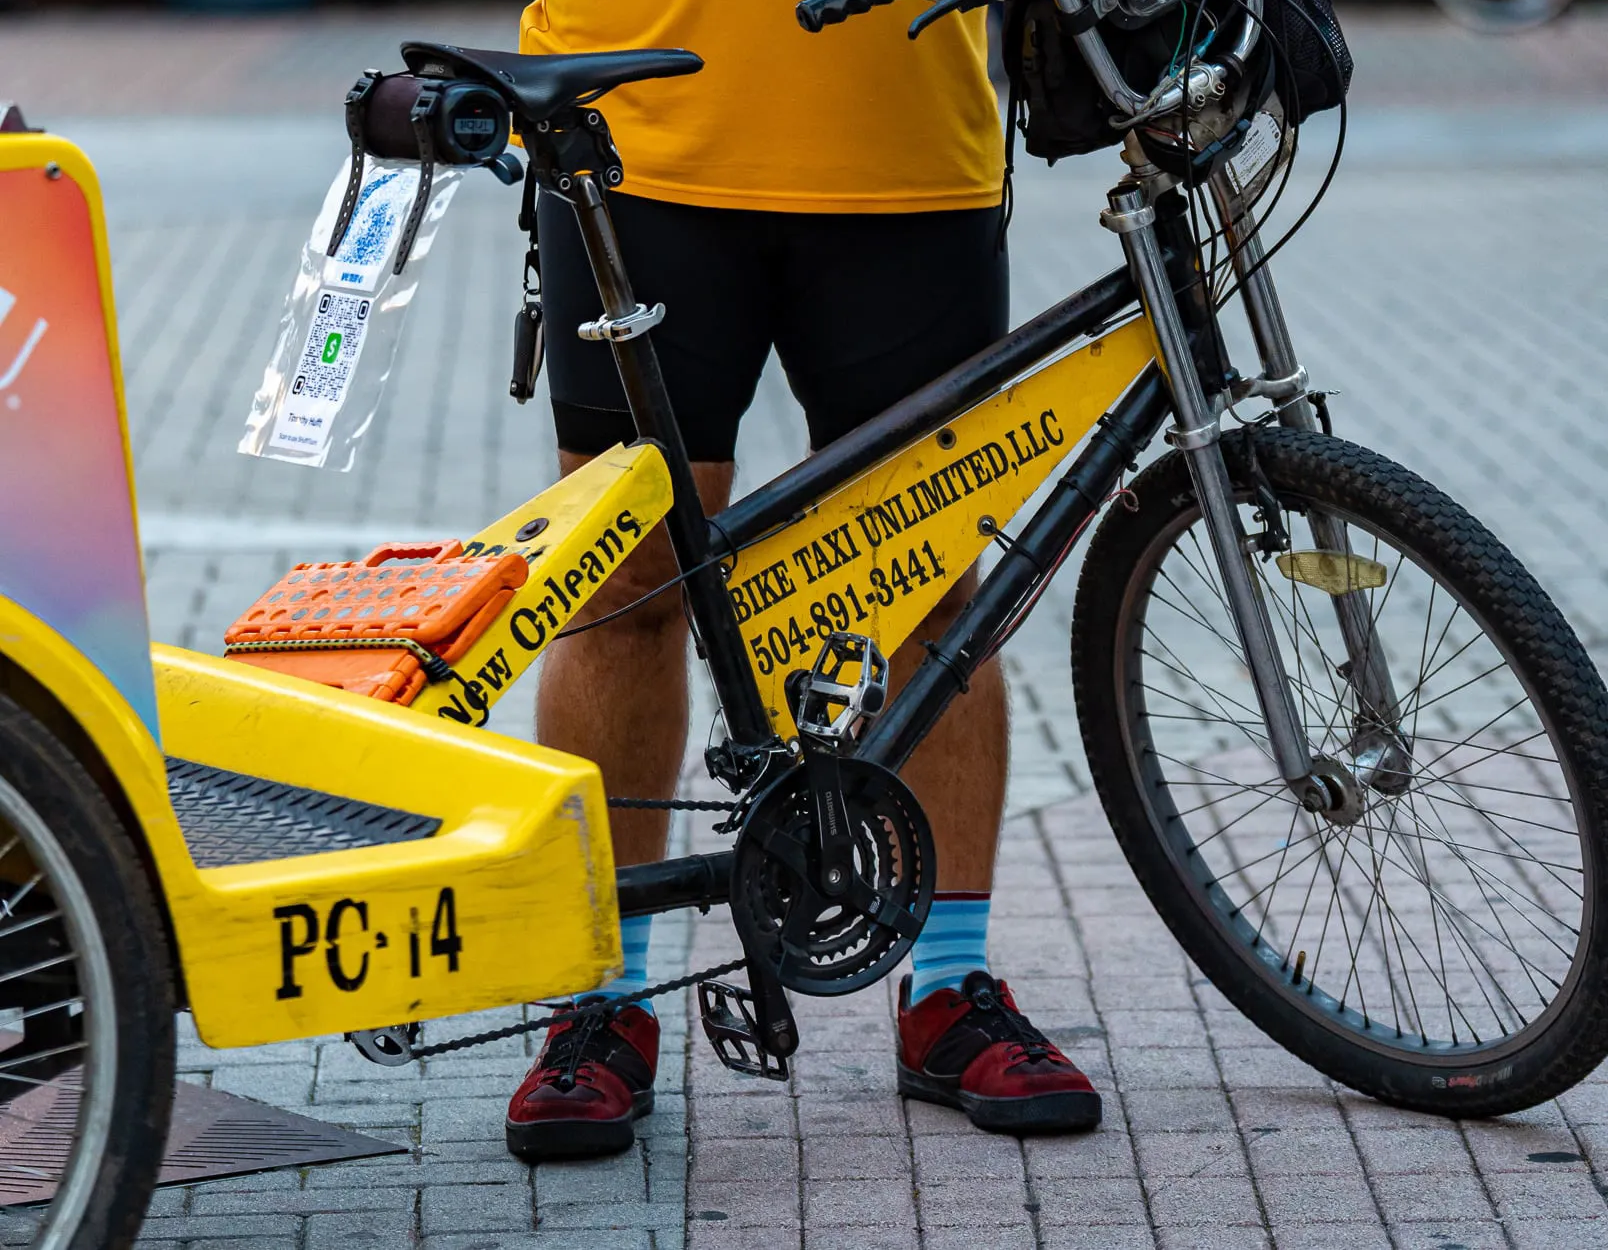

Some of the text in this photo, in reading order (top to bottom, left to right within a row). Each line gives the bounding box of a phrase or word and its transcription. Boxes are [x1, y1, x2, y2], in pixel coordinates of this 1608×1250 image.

[510, 509, 642, 651] Orleans
[729, 408, 1065, 625] BIKE TAXI UNLIMITED,LLC
[750, 540, 946, 675] 504-891-3441
[825, 791, 838, 836] SHIMANO
